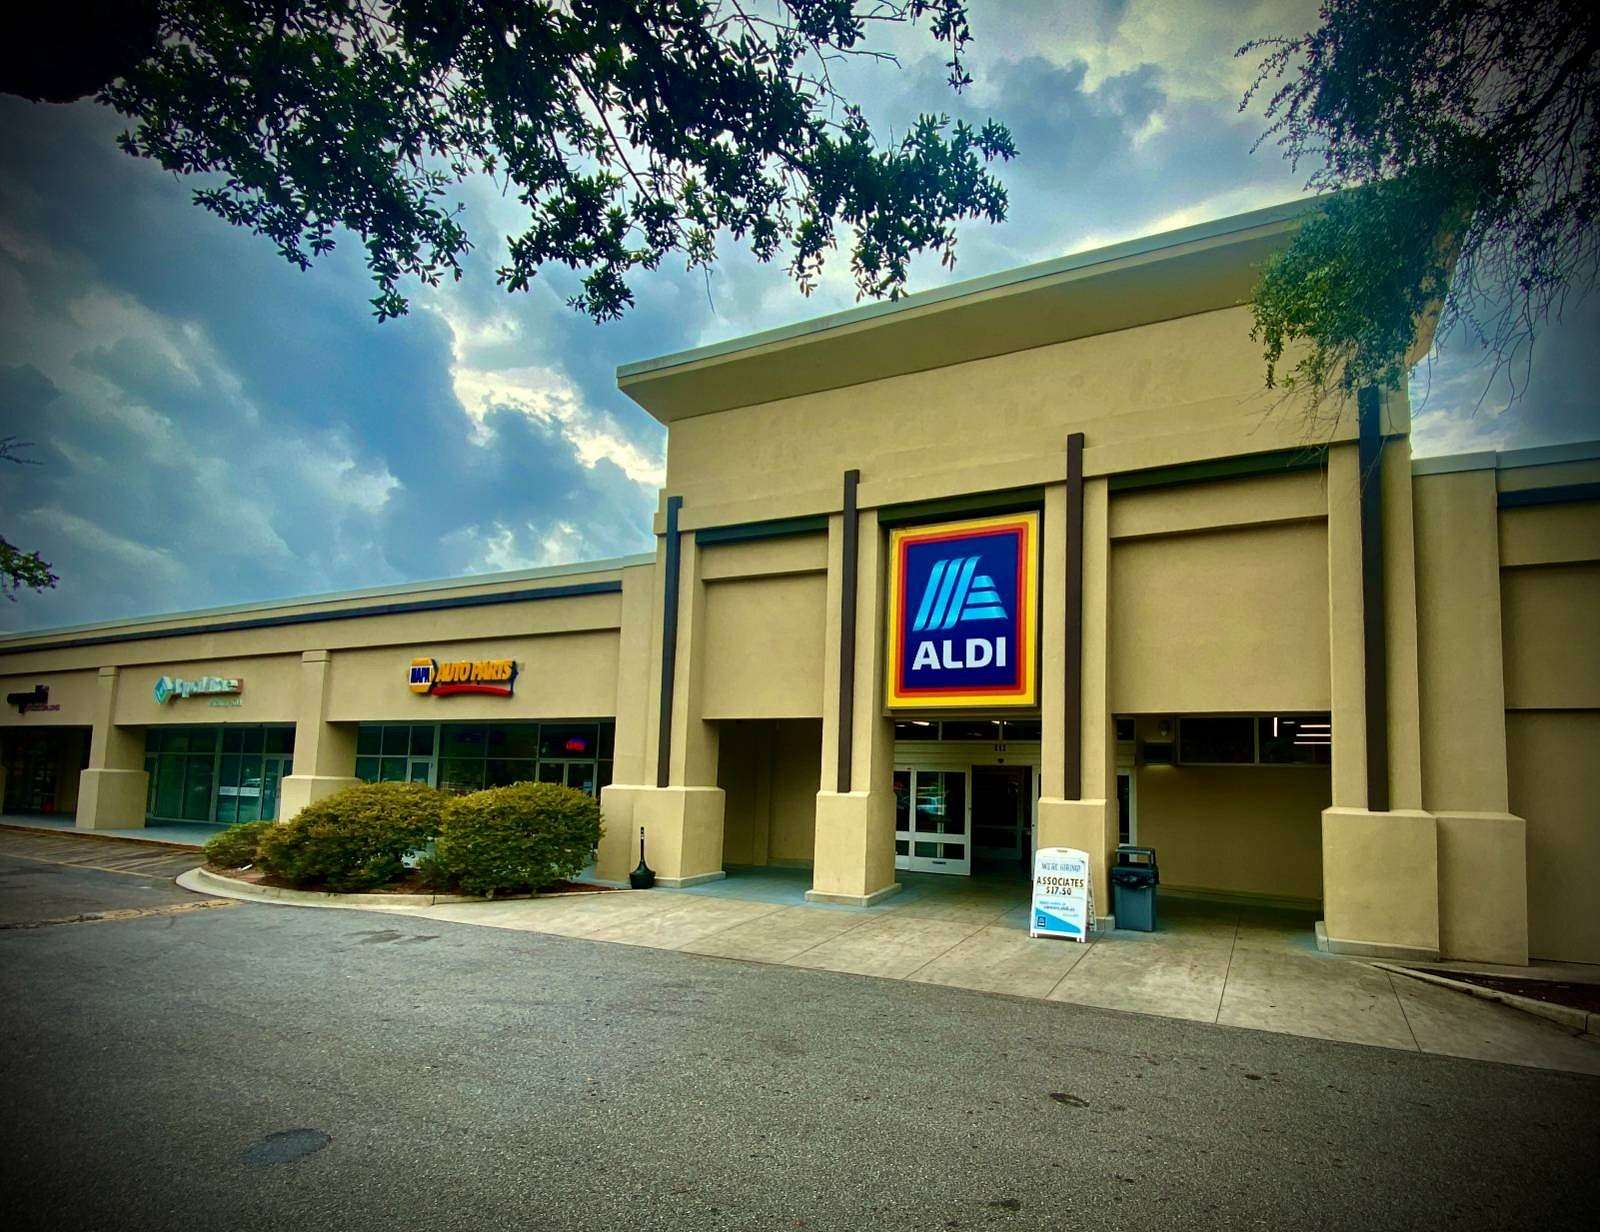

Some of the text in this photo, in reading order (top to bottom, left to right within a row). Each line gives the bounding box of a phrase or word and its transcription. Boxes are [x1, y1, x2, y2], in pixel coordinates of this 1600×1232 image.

[912, 637, 1007, 670] ALDI
[436, 659, 513, 681] AUTO PARTS
[1037, 876, 1084, 888] ASSOCIATES
[1046, 887, 1072, 896] $17.50
